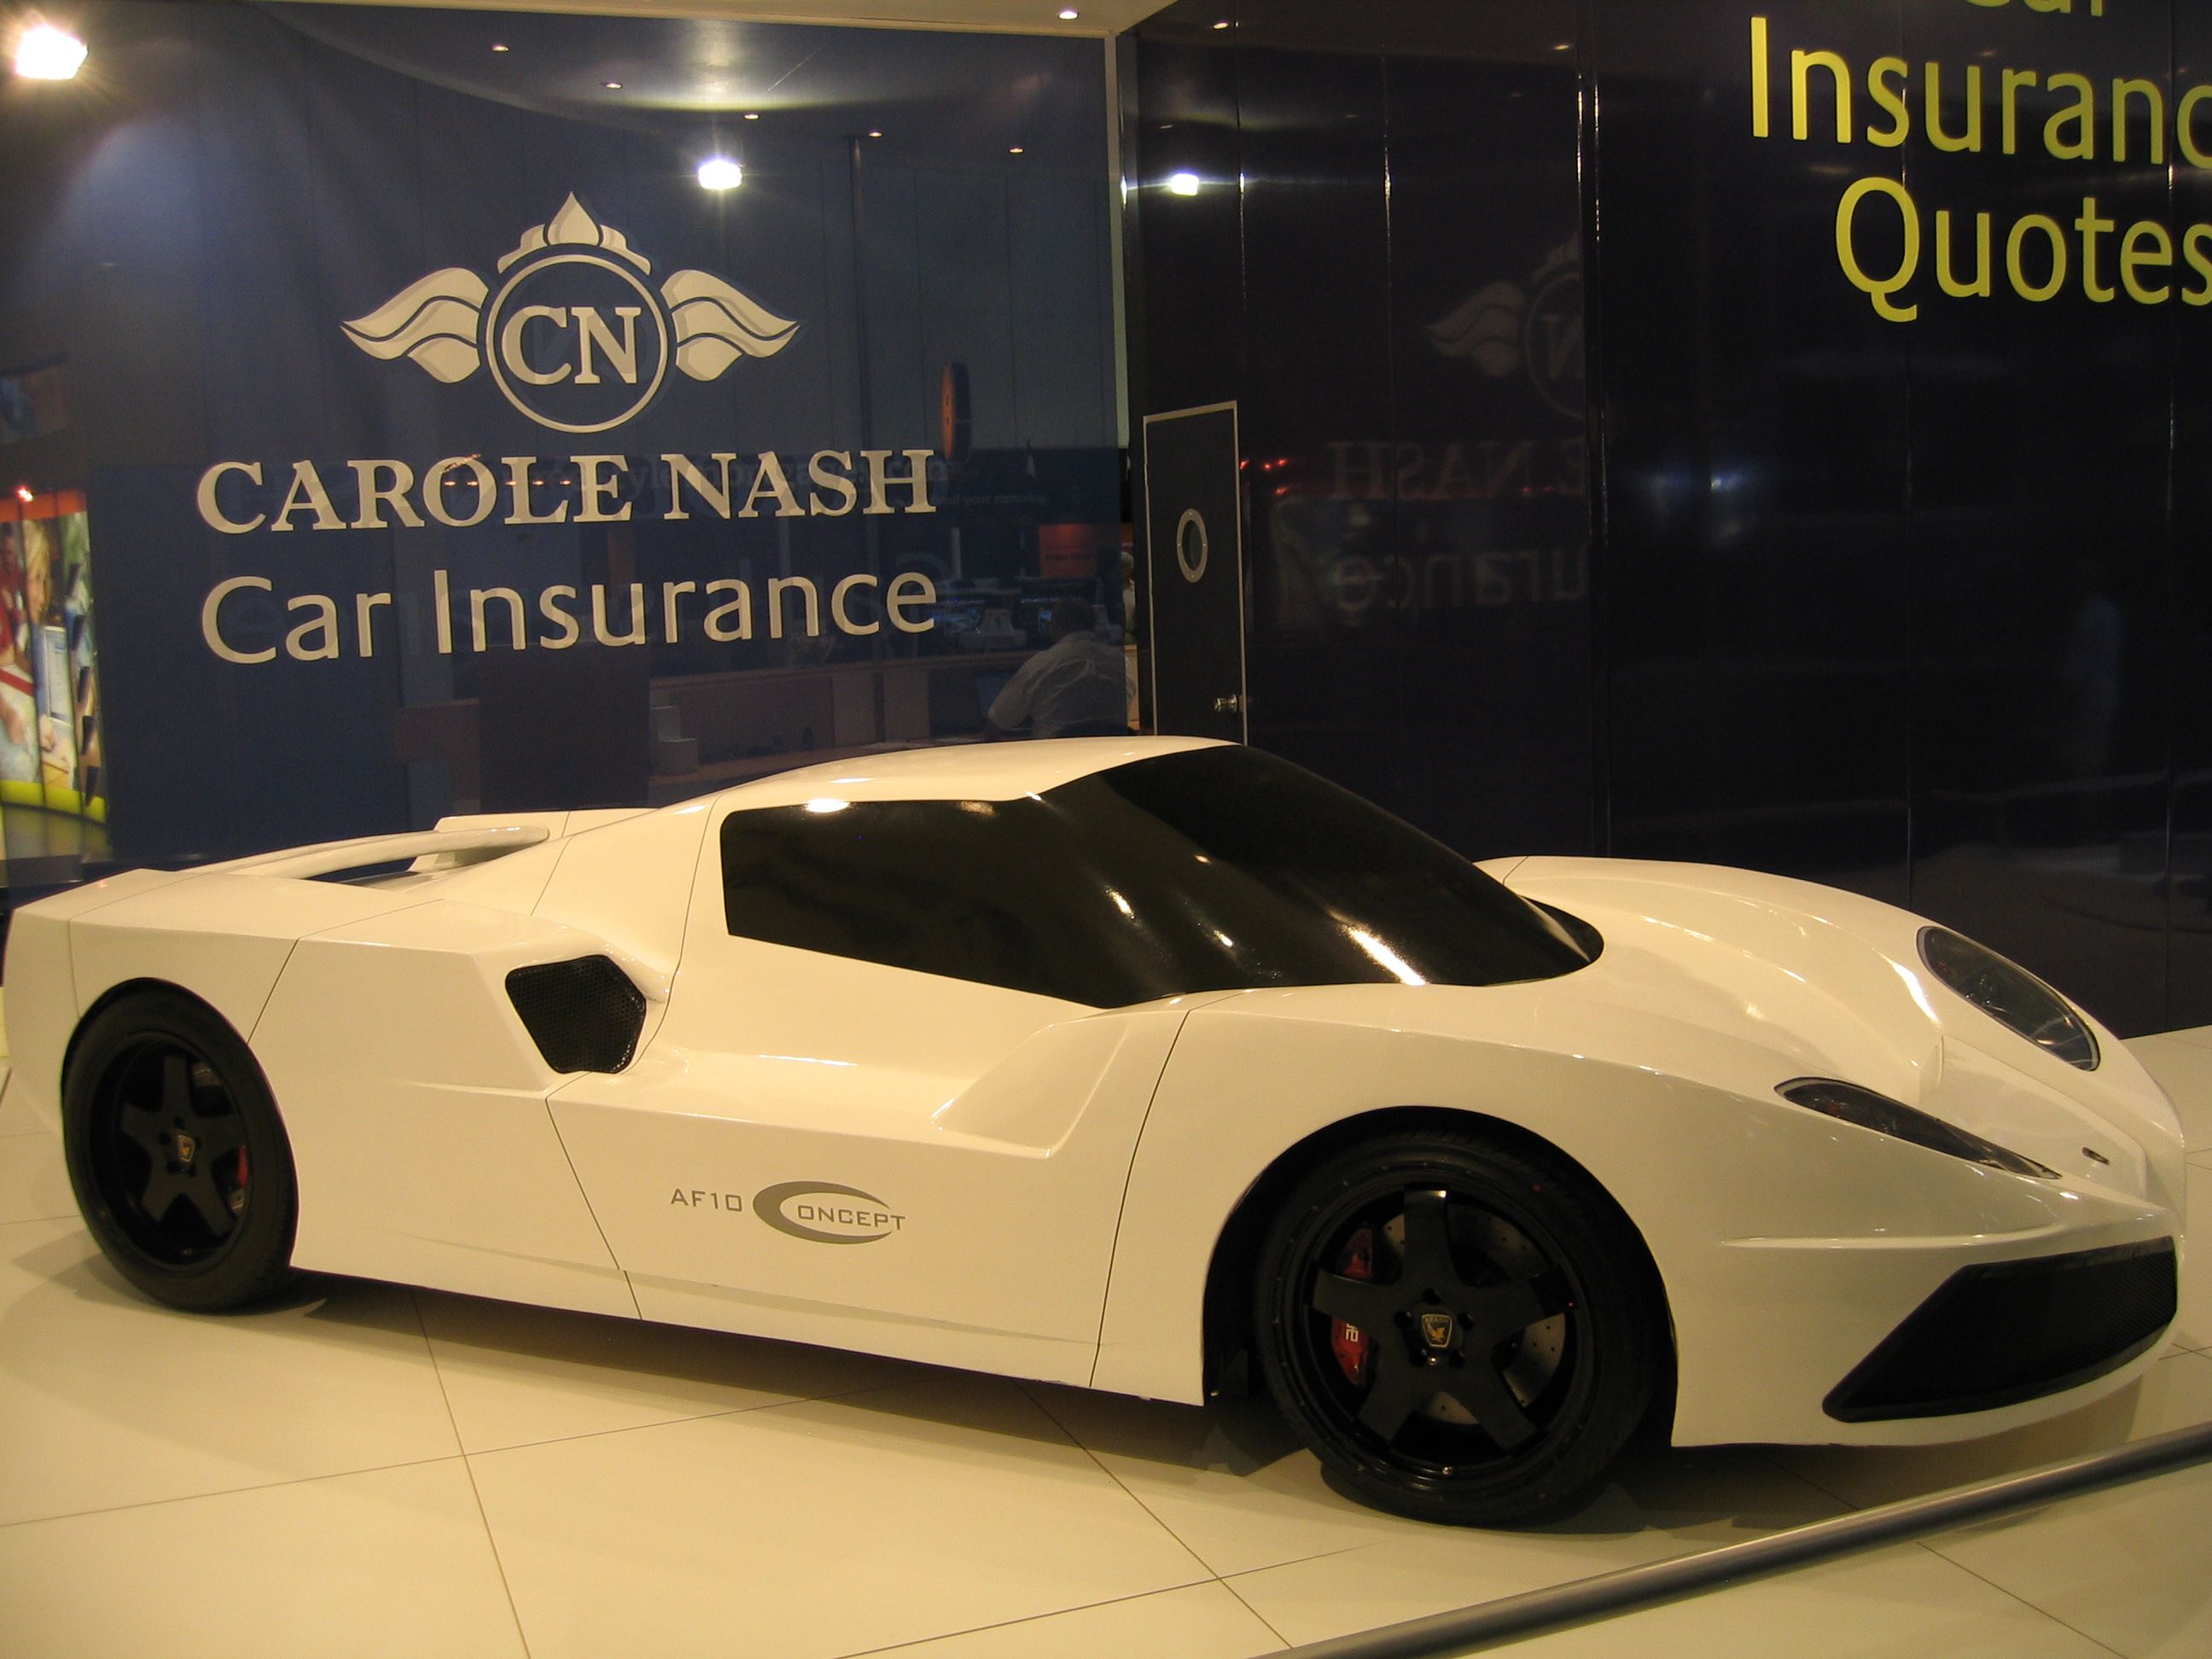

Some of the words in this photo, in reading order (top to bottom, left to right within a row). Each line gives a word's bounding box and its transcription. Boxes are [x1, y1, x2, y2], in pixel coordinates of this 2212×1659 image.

[1750, 15, 2212, 168] Insuranc
[1836, 177, 2212, 322] Quotes
[501, 306, 642, 386] CN
[197, 454, 632, 534] CAROLE
[662, 450, 936, 519] NASH
[201, 576, 392, 664] Car
[434, 569, 935, 654] Insurance
[671, 1189, 742, 1212] AF10
